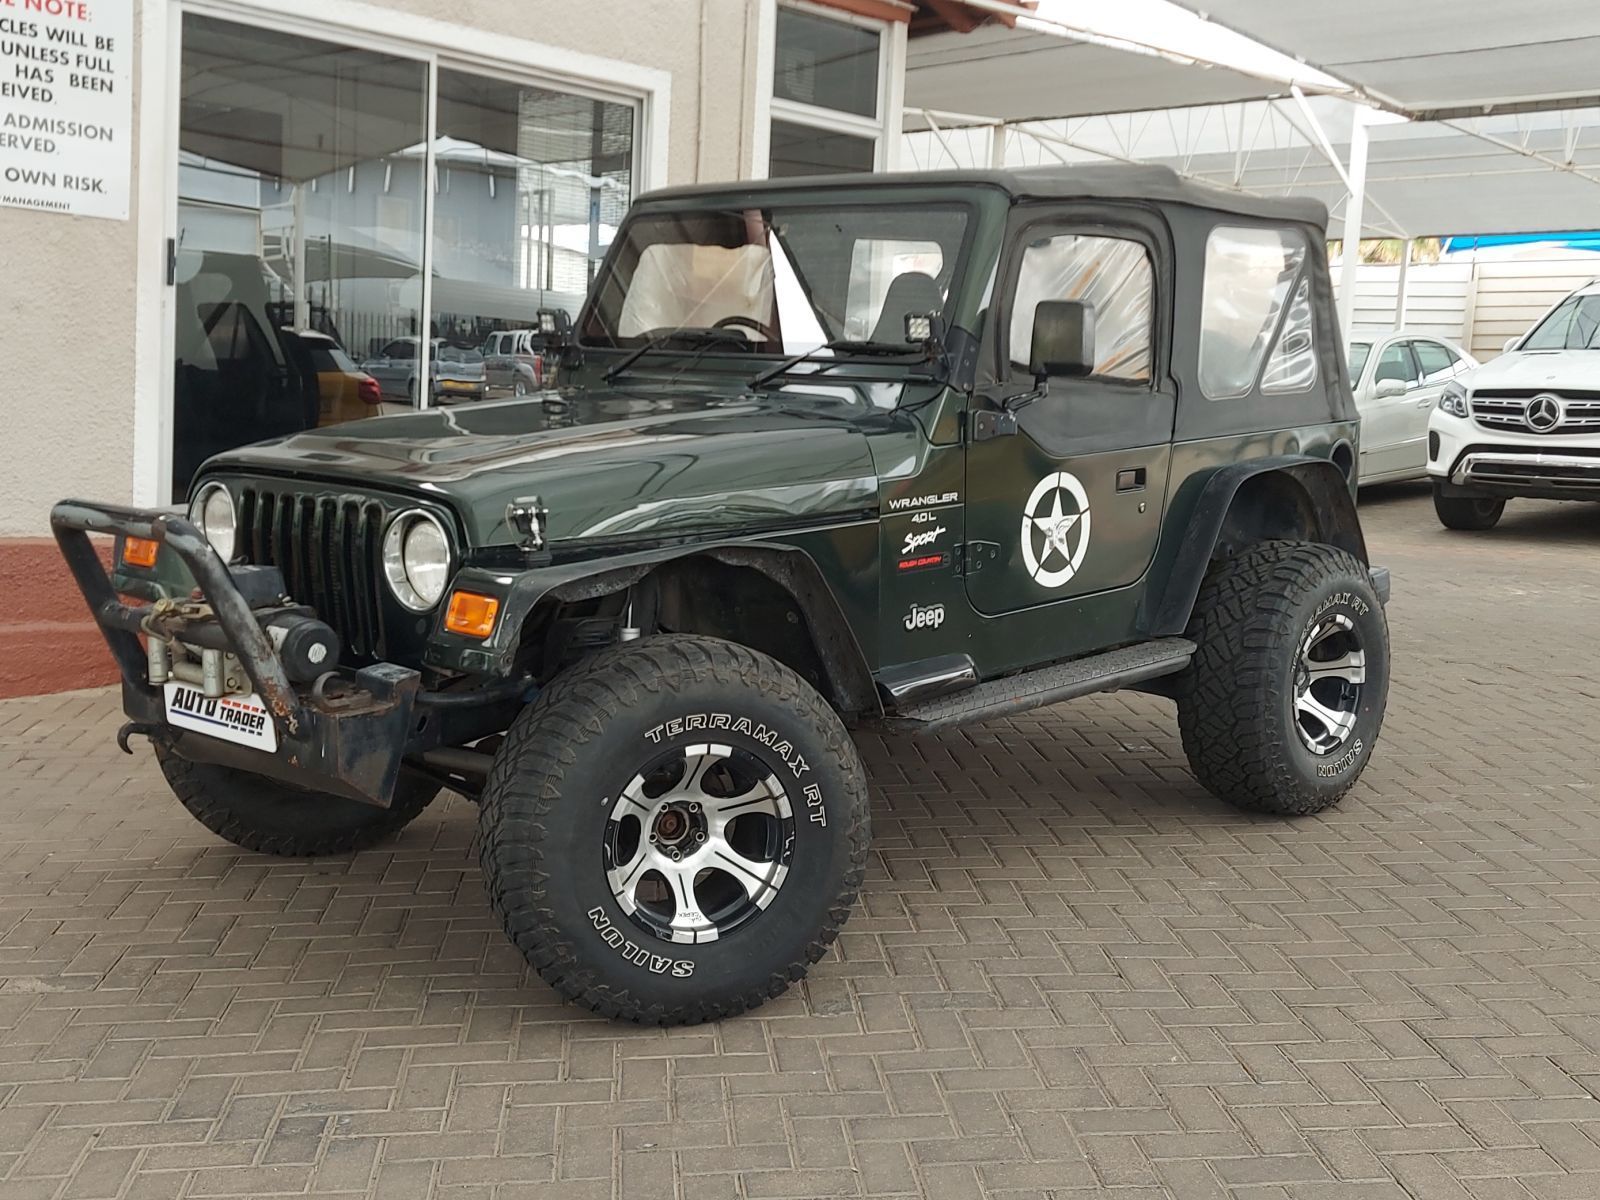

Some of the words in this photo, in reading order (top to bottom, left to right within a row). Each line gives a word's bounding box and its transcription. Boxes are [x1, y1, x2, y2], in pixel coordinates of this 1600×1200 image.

[25, 0, 92, 22] NOTE:
[0, 18, 38, 38] CLES
[46, 26, 88, 48] WILL
[95, 35, 115, 52] BE
[1, 40, 69, 66] UNLESS
[76, 54, 114, 74] FULL
[1, 82, 57, 105] EIVED.
[15, 63, 54, 84] HAS
[69, 73, 113, 94] BEEN
[4, 112, 113, 142] ADMISSION
[0, 132, 60, 155] ERVED.
[4, 167, 56, 187] OWN
[63, 174, 107, 194] RISK.
[2, 195, 70, 211] MANAGEMENT
[888, 492, 958, 510] WRANGLER
[903, 603, 945, 630] Jeep
[171, 687, 218, 717] AUTO
[219, 706, 265, 730] TRADER
[644, 713, 811, 779] TERRAMAX
[803, 783, 827, 827] RT
[1317, 738, 1363, 777] SAILUN
[588, 906, 695, 977] SAILUN
